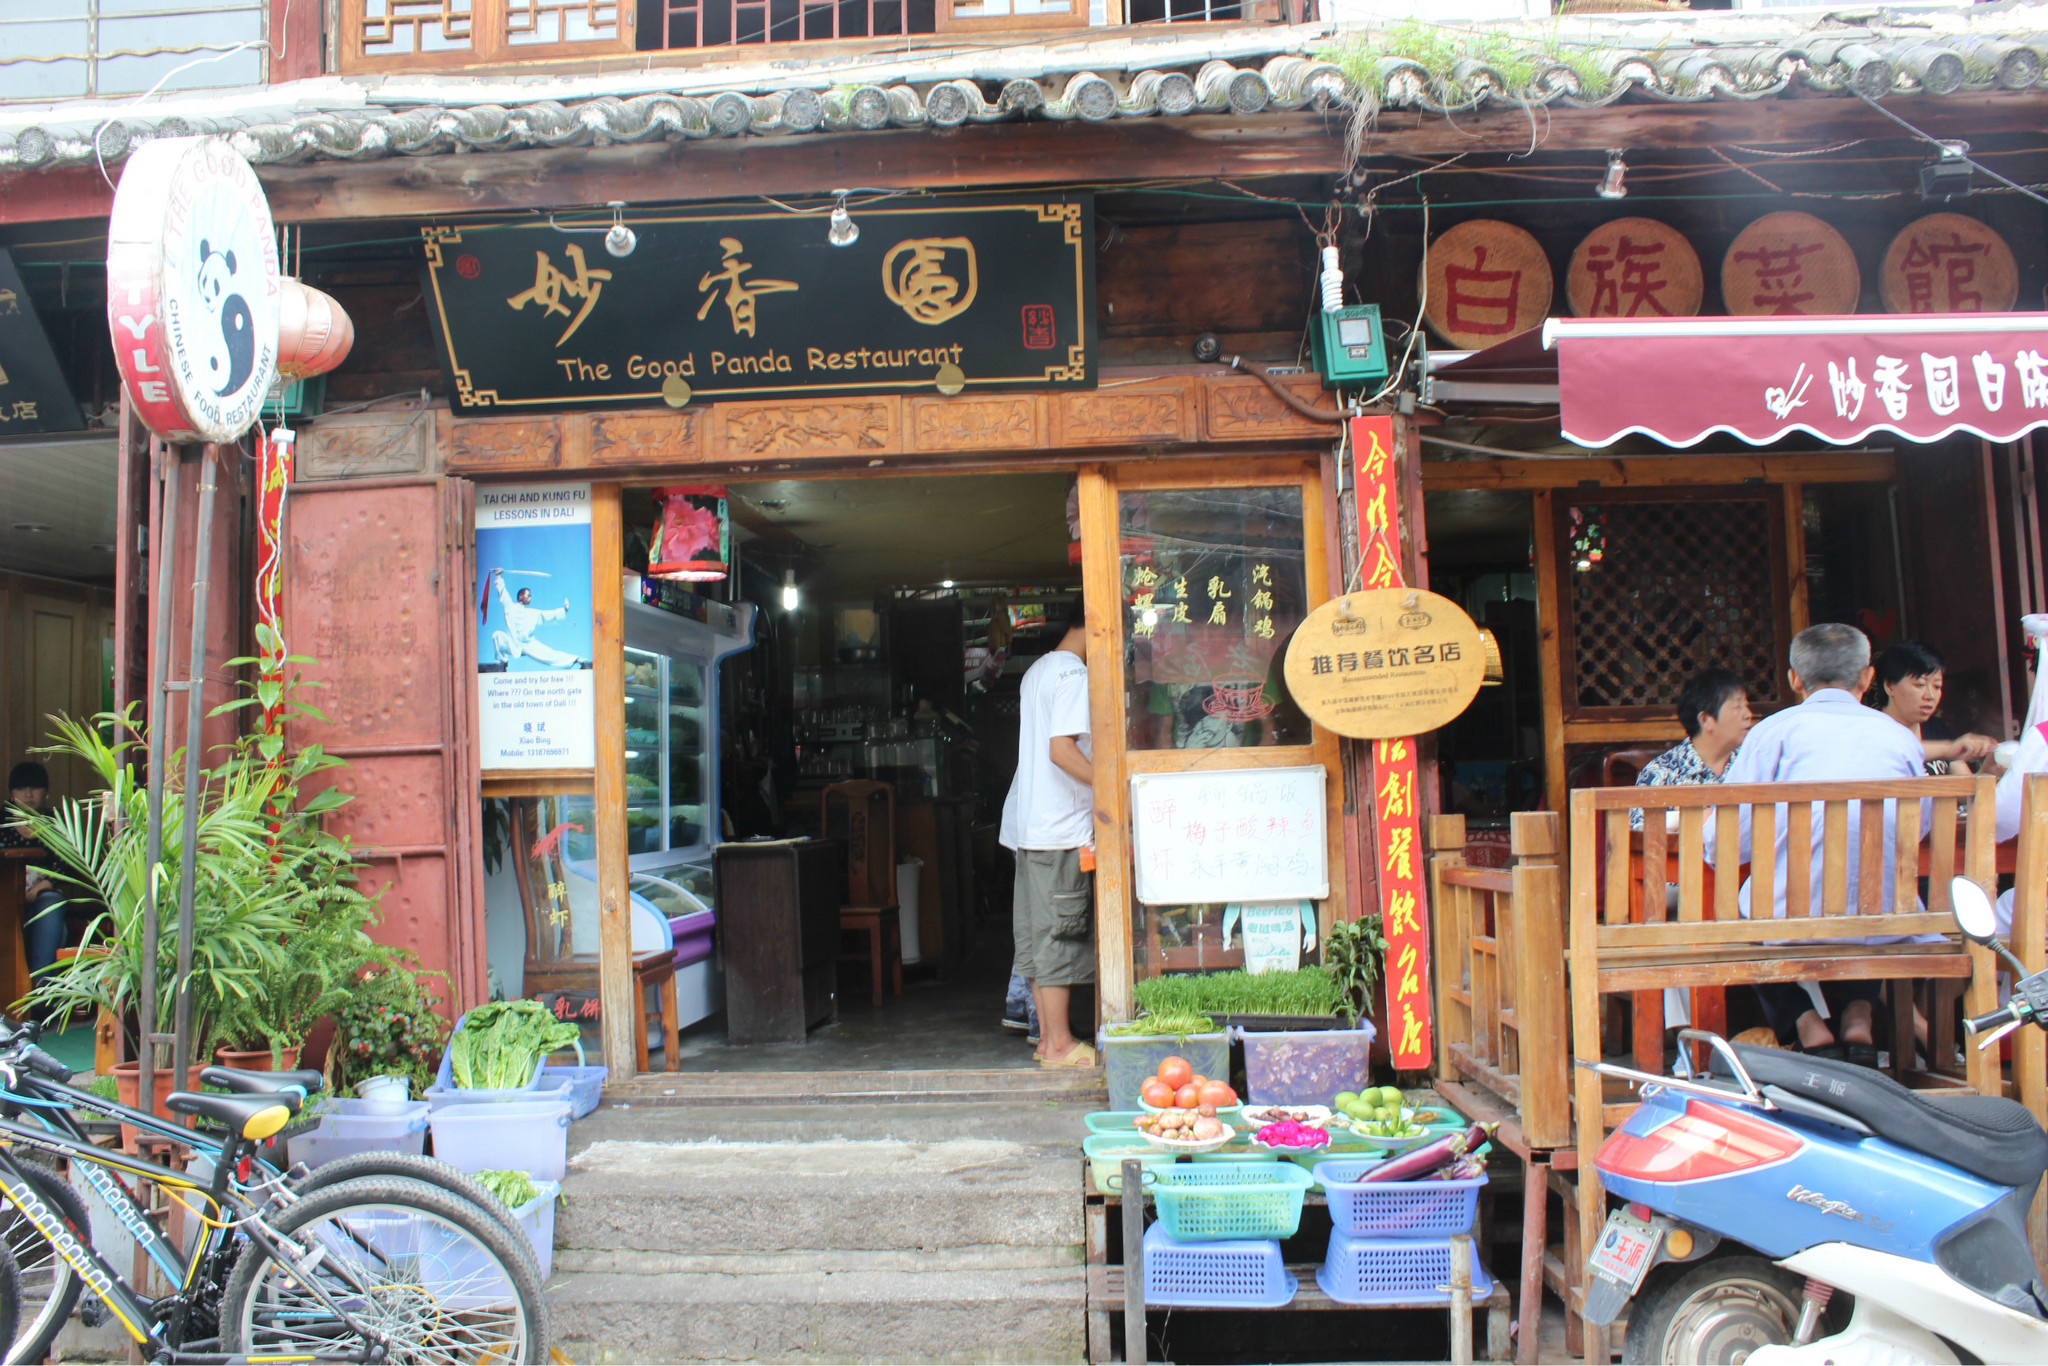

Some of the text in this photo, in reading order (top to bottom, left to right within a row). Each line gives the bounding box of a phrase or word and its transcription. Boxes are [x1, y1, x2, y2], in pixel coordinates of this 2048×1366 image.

[169, 153, 278, 297] THE GOOD PANDA
[170, 298, 271, 425] CHINESE FOOD RESTAURANT
[557, 343, 963, 382] The Good Panda Restaurant
[0, 401, 38, 422] 店
[483, 490, 585, 504] TAI CHI AND KUNG FU
[494, 507, 574, 520] LESSONS IN DALI
[1172, 576, 1192, 624] 生皮
[1206, 575, 1231, 626] 乳扇
[1251, 564, 1275, 639] 汽锅鸡
[1311, 642, 1461, 675] 推荐餐饮名店
[493, 677, 512, 685] Come
[529, 677, 538, 685] try
[565, 674, 574, 682] !!!
[511, 688, 521, 696] ???
[523, 688, 533, 696] On
[534, 688, 545, 696] the
[547, 687, 565, 695] north
[567, 687, 582, 695] gate
[514, 700, 525, 708] old
[526, 700, 544, 708] town
[545, 699, 552, 707] of
[553, 699, 566, 707] Dali
[568, 698, 576, 707] !!!
[519, 736, 551, 745] Xiao Bing
[78, 1159, 155, 1248] omentum
[7, 1182, 113, 1297] momentum
[1612, 1236, 1647, 1268] 王派
